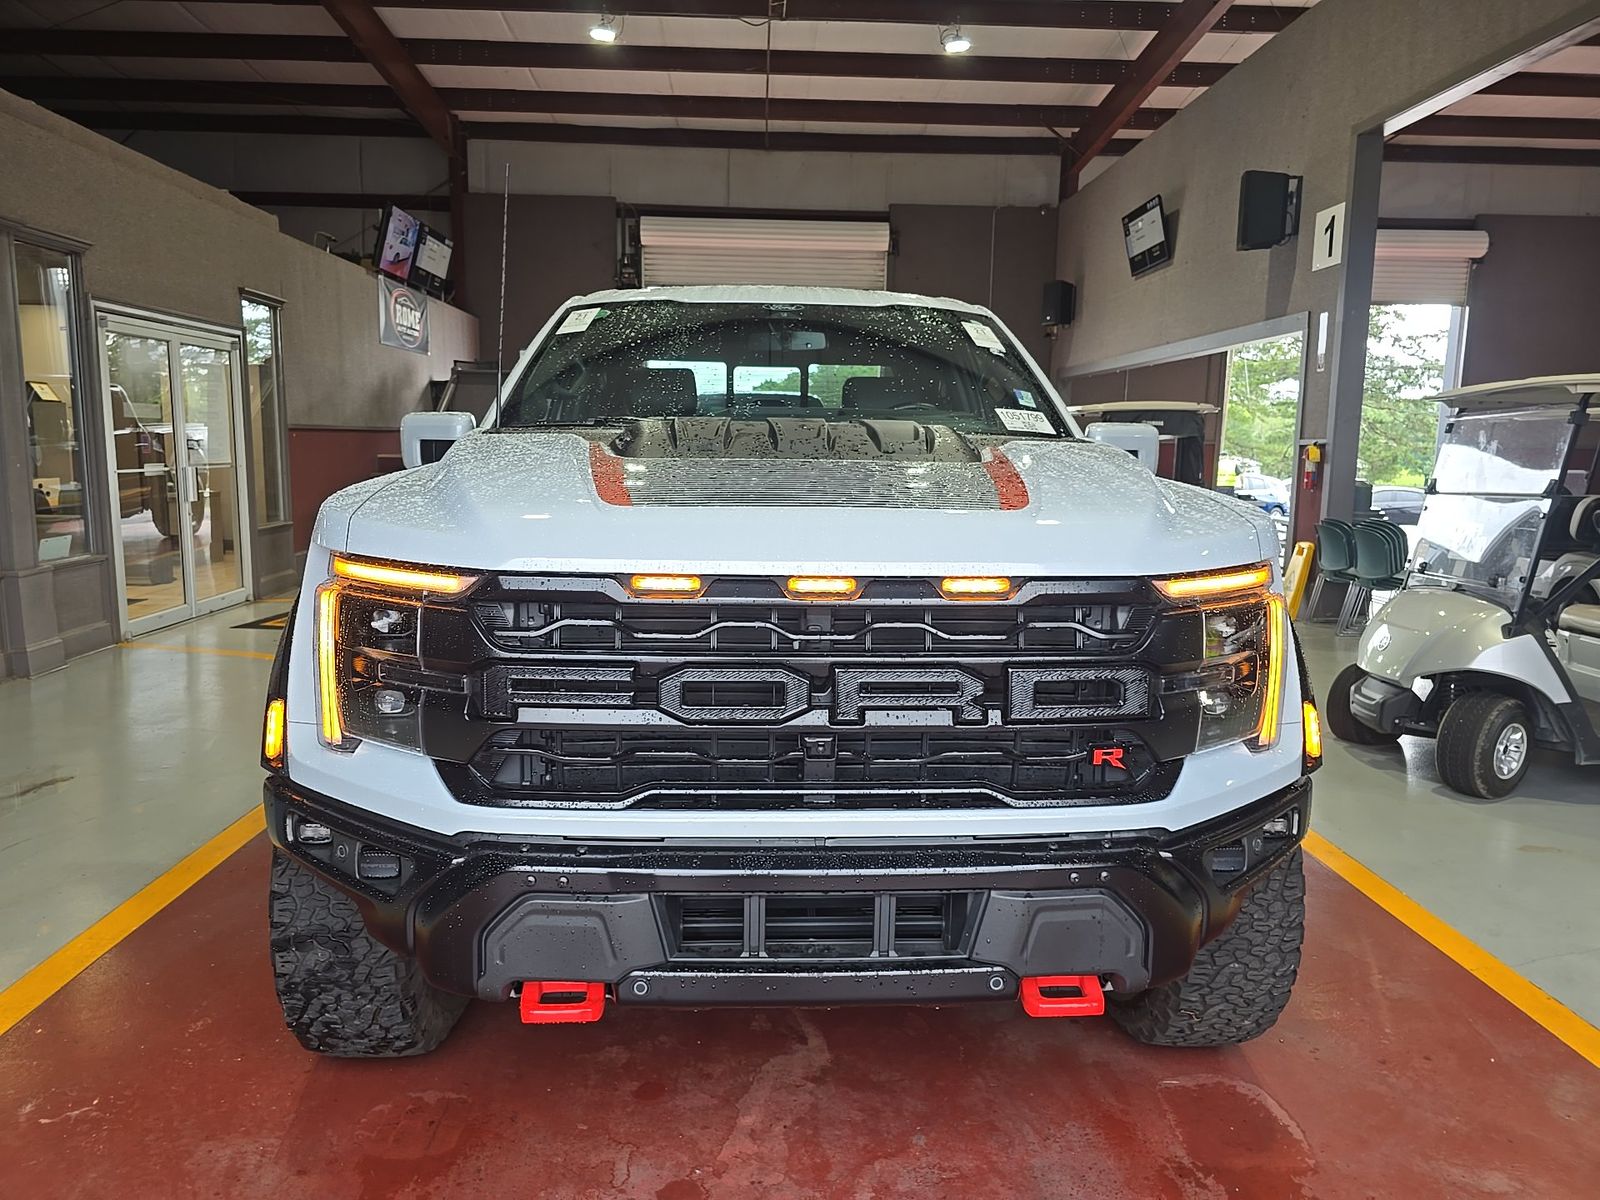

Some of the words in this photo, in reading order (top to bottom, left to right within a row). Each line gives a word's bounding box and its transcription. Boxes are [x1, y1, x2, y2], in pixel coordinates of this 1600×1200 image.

[1324, 214, 1336, 258] 1
[395, 303, 421, 331] ROME
[1000, 411, 1045, 423] 1051799
[482, 664, 1150, 721] FORD
[1093, 748, 1126, 770] R
